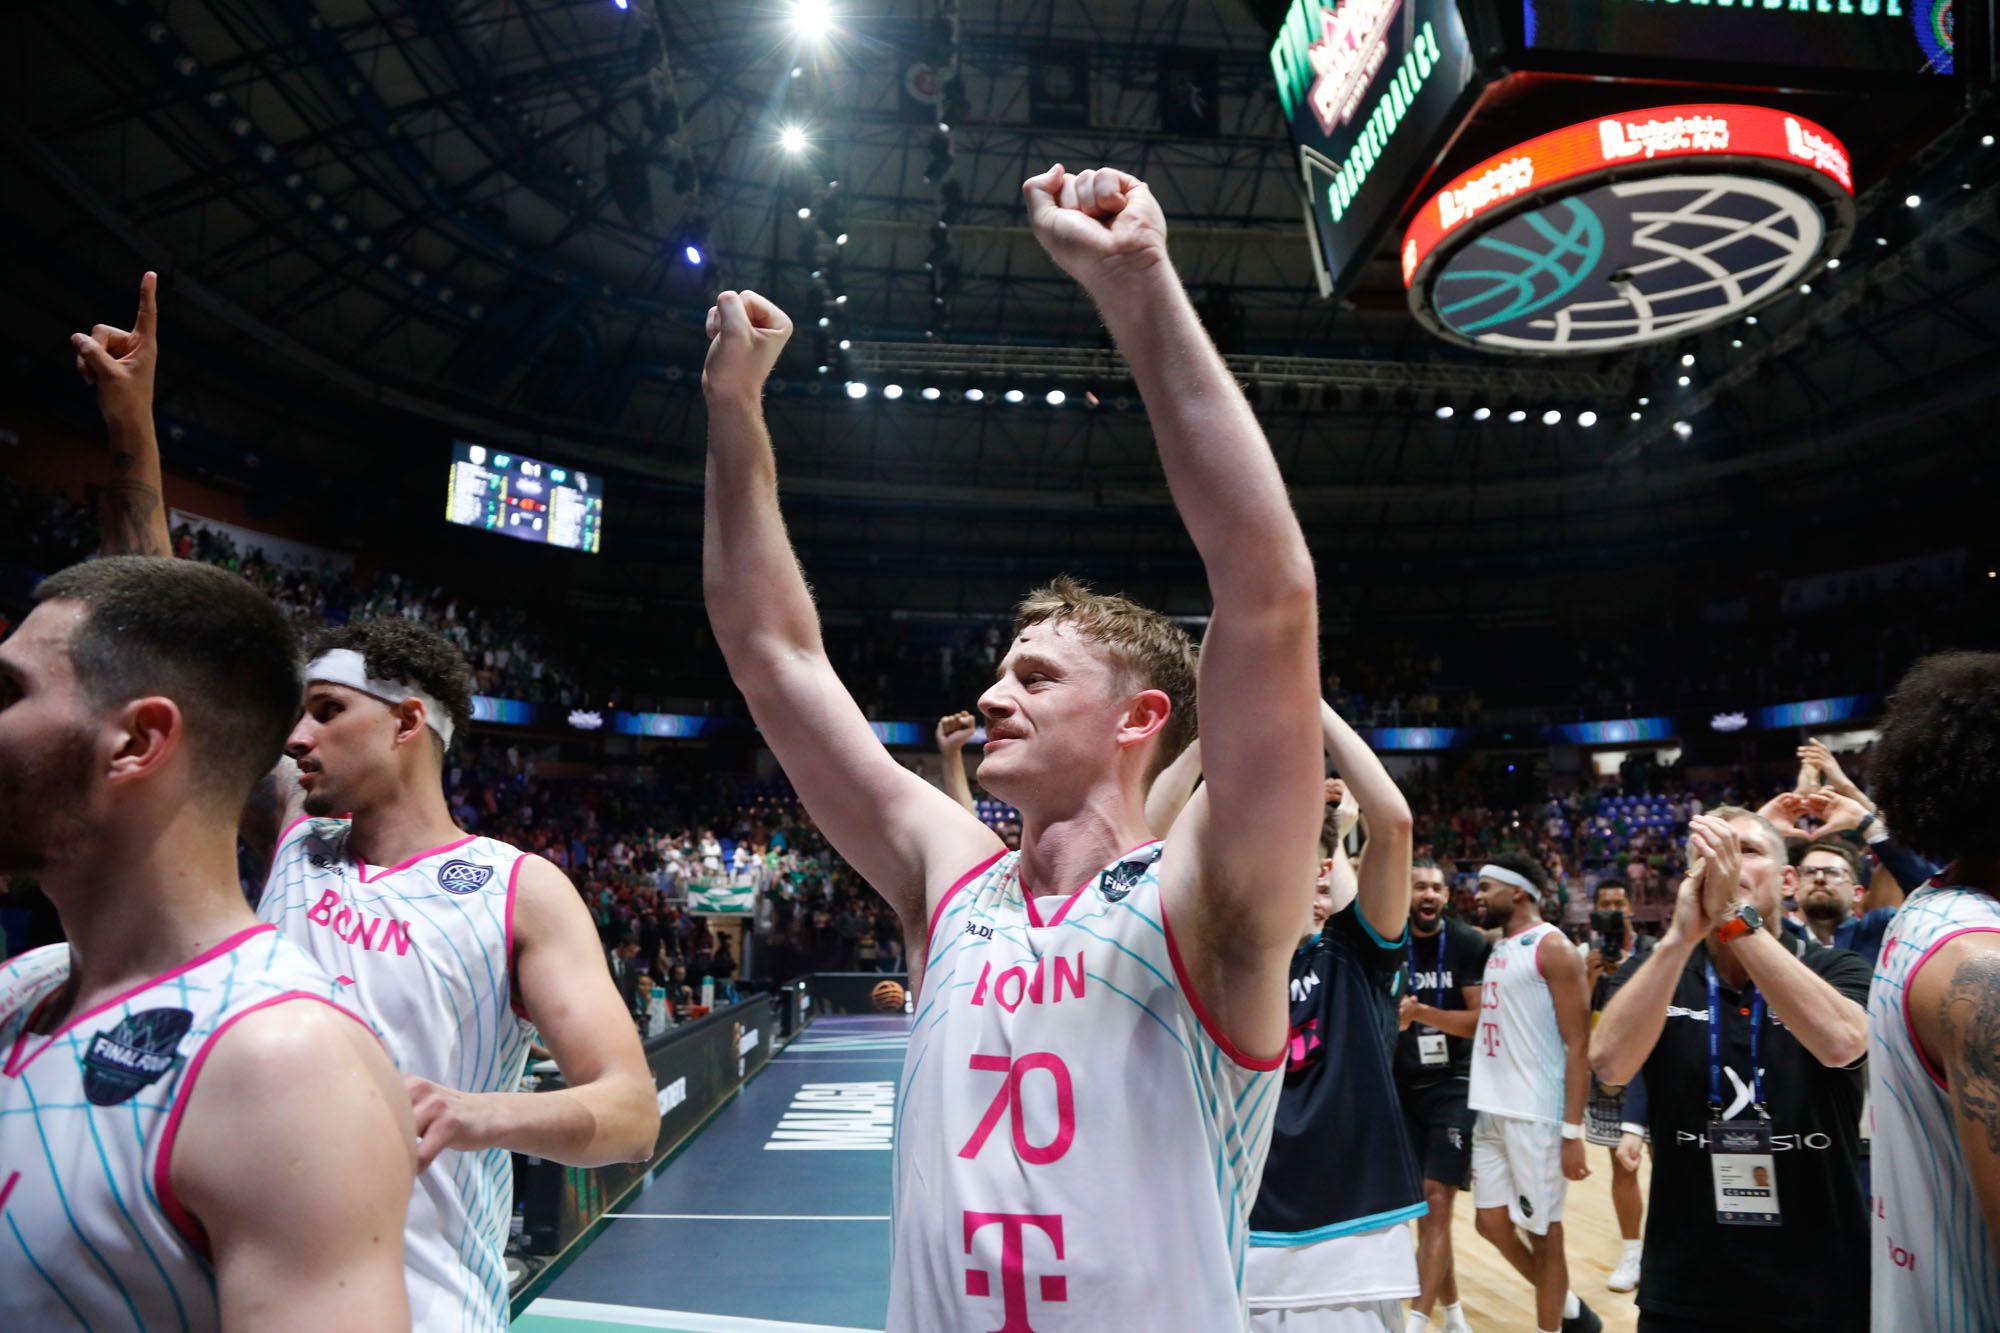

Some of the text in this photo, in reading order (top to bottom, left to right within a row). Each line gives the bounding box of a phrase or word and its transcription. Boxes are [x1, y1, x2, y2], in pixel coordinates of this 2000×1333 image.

[93, 1037, 172, 1072] FINAL FOUR
[763, 1080, 897, 1150] MALAGA
[958, 1052, 1076, 1165] 70
[1676, 1130, 1832, 1151] PHSIO
